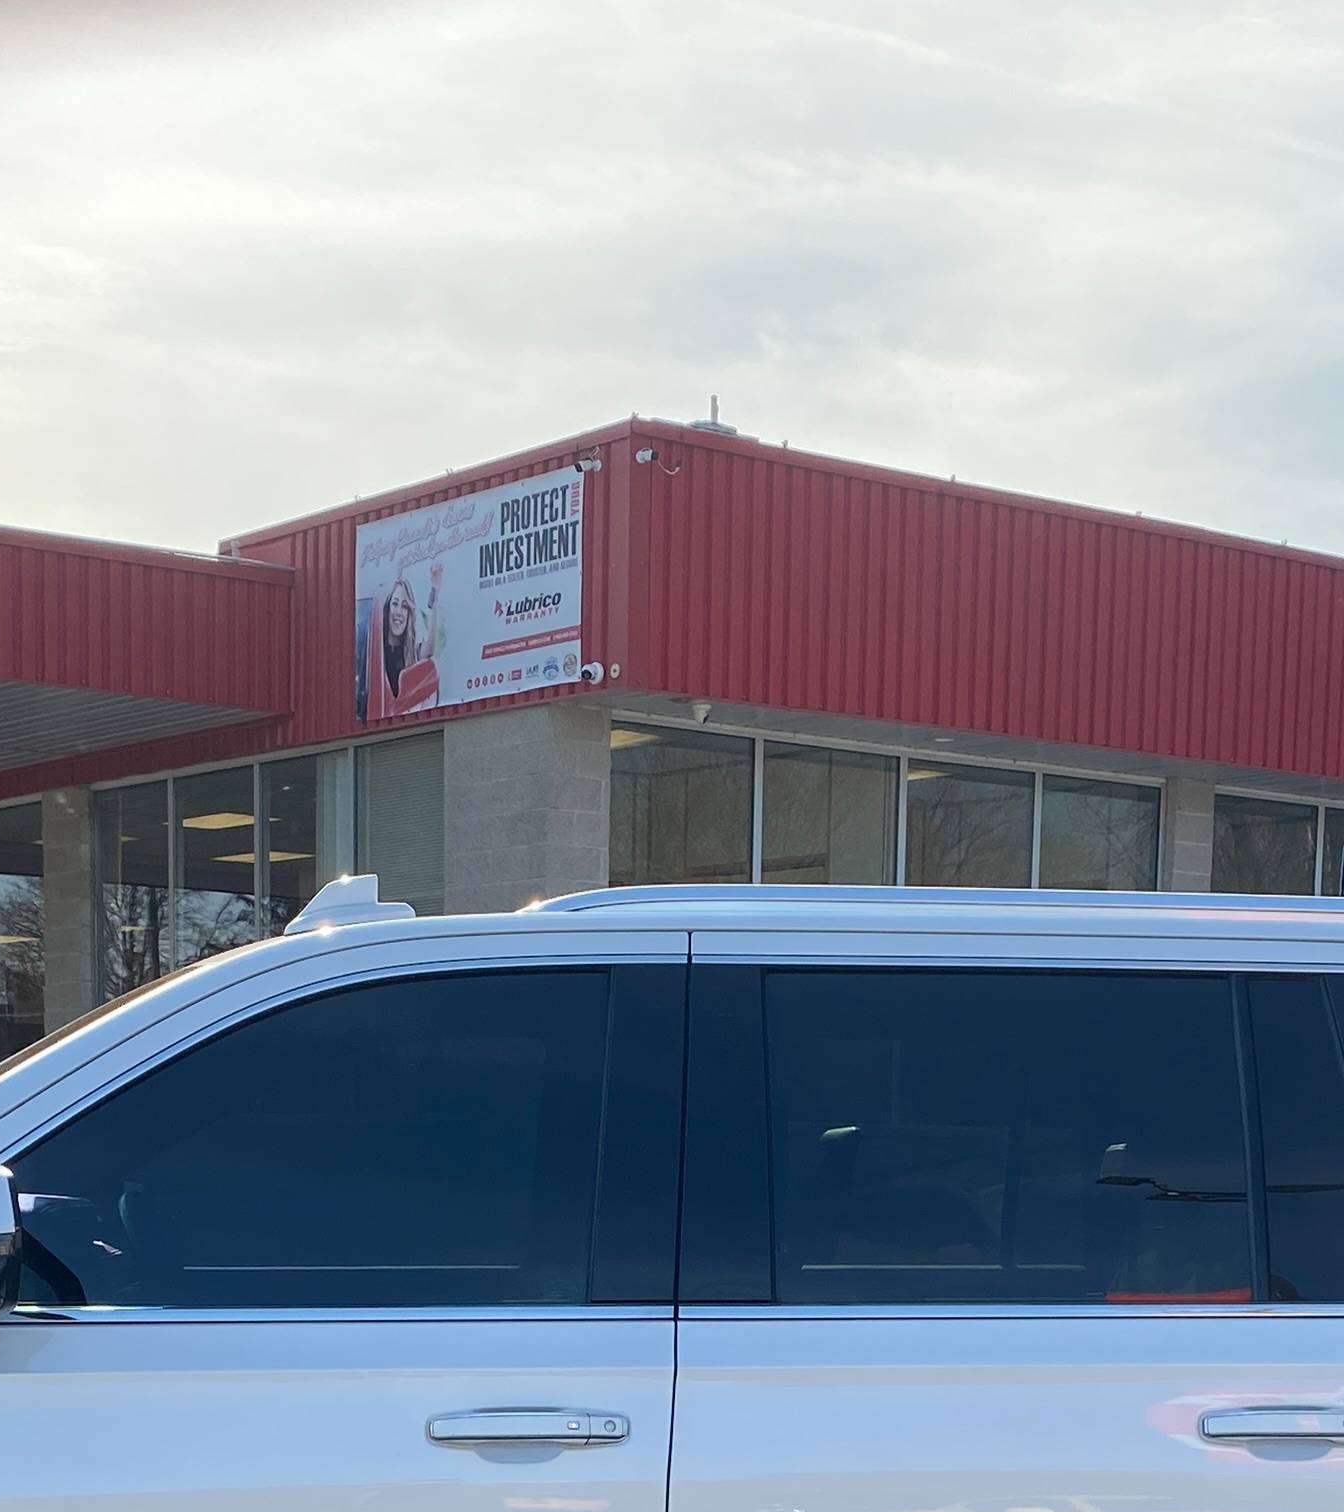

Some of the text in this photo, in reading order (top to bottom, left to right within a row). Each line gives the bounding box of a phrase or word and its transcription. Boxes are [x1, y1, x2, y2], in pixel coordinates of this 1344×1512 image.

[500, 484, 569, 537] PROTECT
[479, 520, 580, 579] INVESTMENT
[505, 606, 561, 625] WARRANTY
[506, 592, 562, 617] Lubrico
